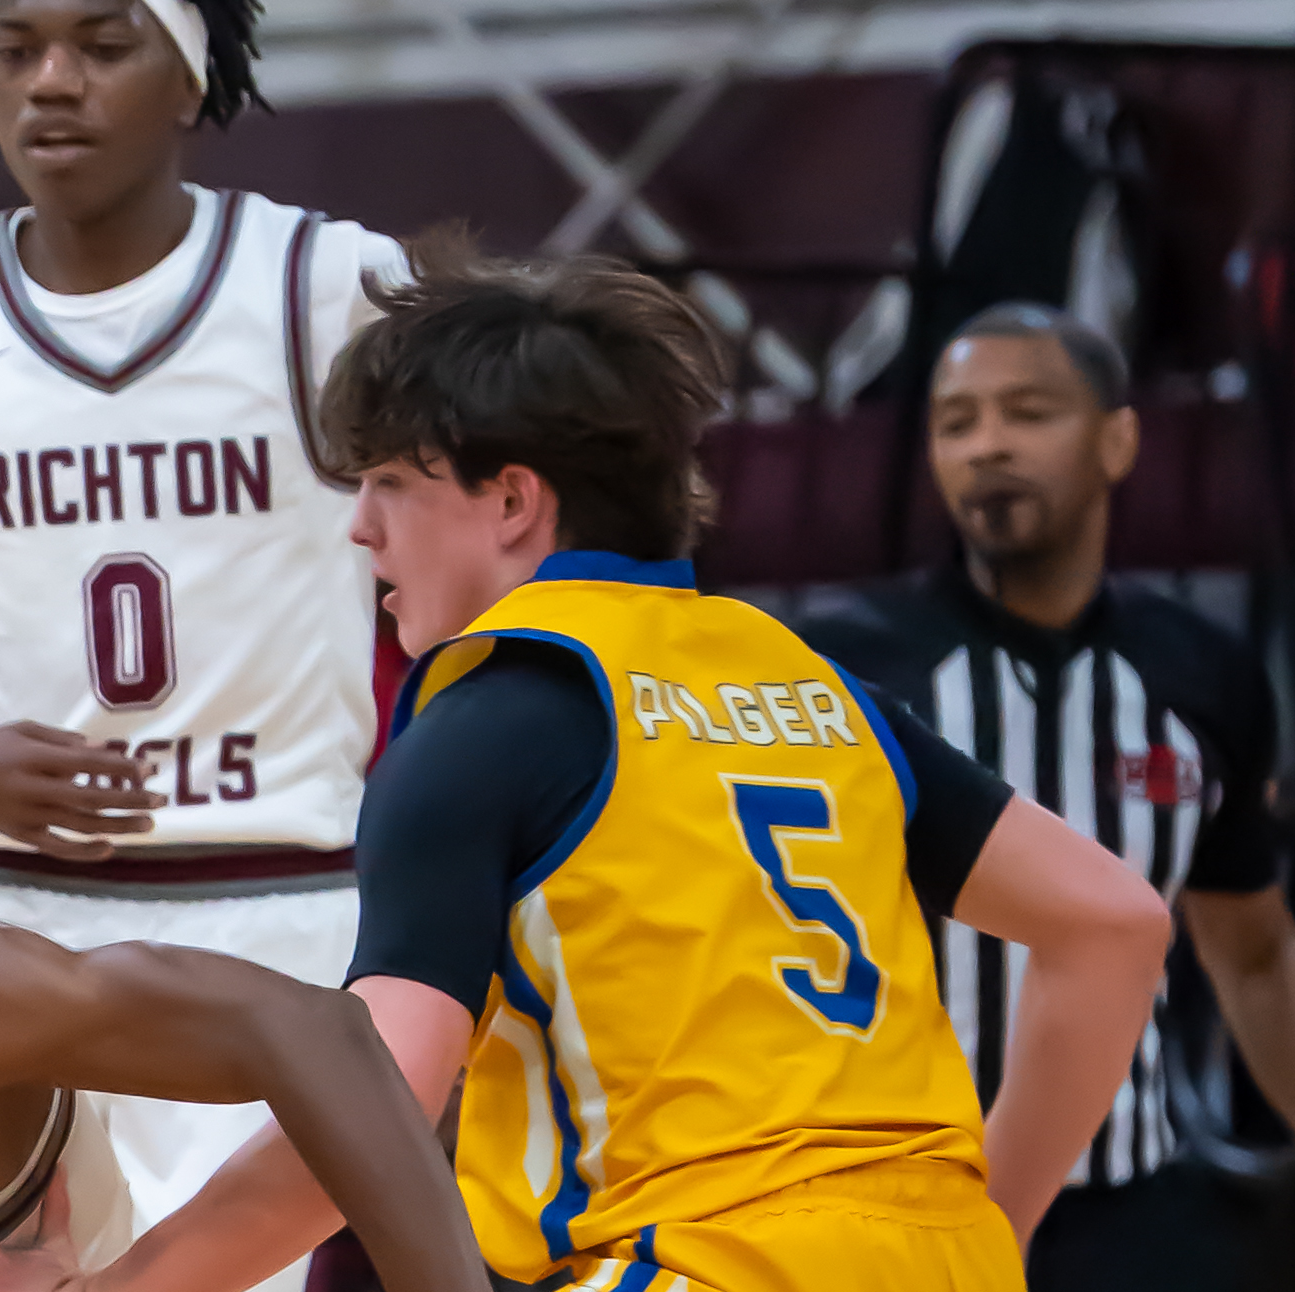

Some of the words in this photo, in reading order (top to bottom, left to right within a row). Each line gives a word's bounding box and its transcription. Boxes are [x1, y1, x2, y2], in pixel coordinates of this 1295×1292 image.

[82, 551, 179, 712] 0
[626, 670, 860, 747] PILGER
[717, 771, 890, 1043] 5
